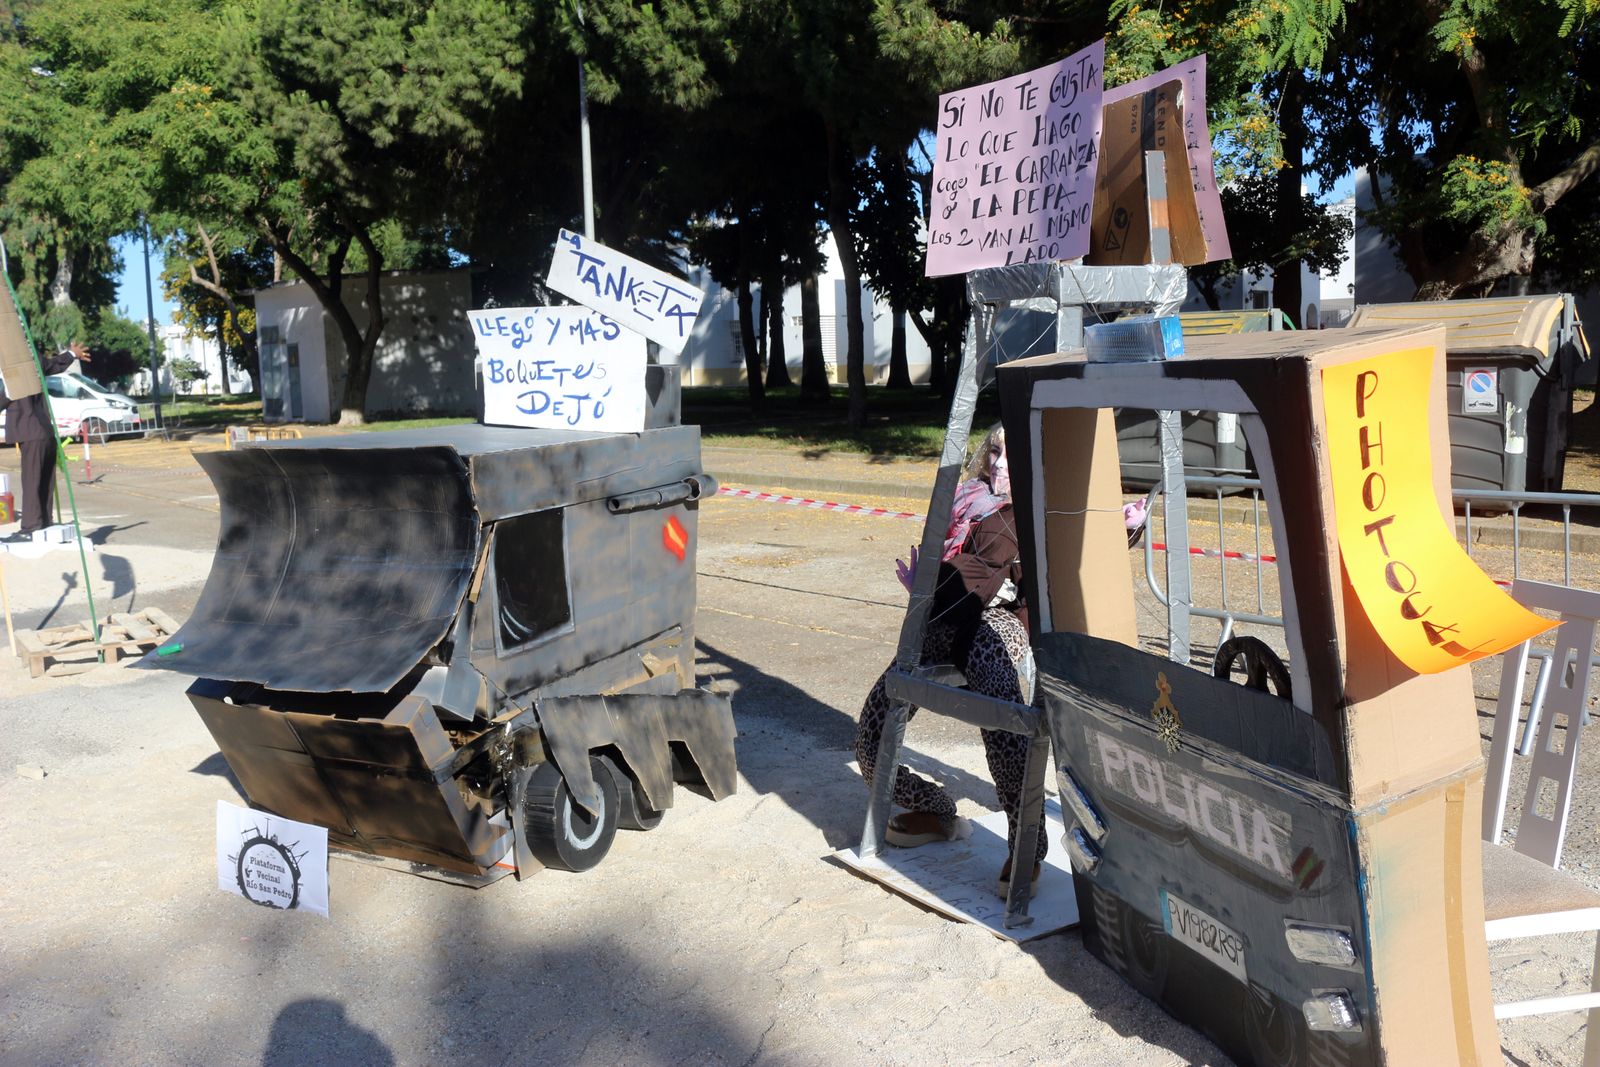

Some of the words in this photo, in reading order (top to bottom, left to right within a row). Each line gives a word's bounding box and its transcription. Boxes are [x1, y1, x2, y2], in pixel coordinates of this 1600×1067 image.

[942, 96, 966, 129] Si
[979, 87, 1004, 123] NO
[1014, 78, 1039, 111] TE
[1049, 54, 1099, 108] GUSTA
[979, 130, 1018, 157] QUE
[1032, 112, 1082, 147] HAGO
[560, 230, 581, 250] LA
[956, 228, 974, 247] 2
[978, 228, 1013, 252] VAN
[1019, 223, 1039, 245] AL
[1004, 242, 1060, 267] LADO
[569, 249, 698, 337] TANKETA
[546, 317, 561, 346] Y
[1099, 737, 1286, 874] POLICIA
[249, 856, 286, 874] Plataforma
[256, 869, 281, 884] Vecinal
[246, 879, 258, 890] Río
[259, 883, 271, 893] San
[273, 886, 292, 900] Pedro
